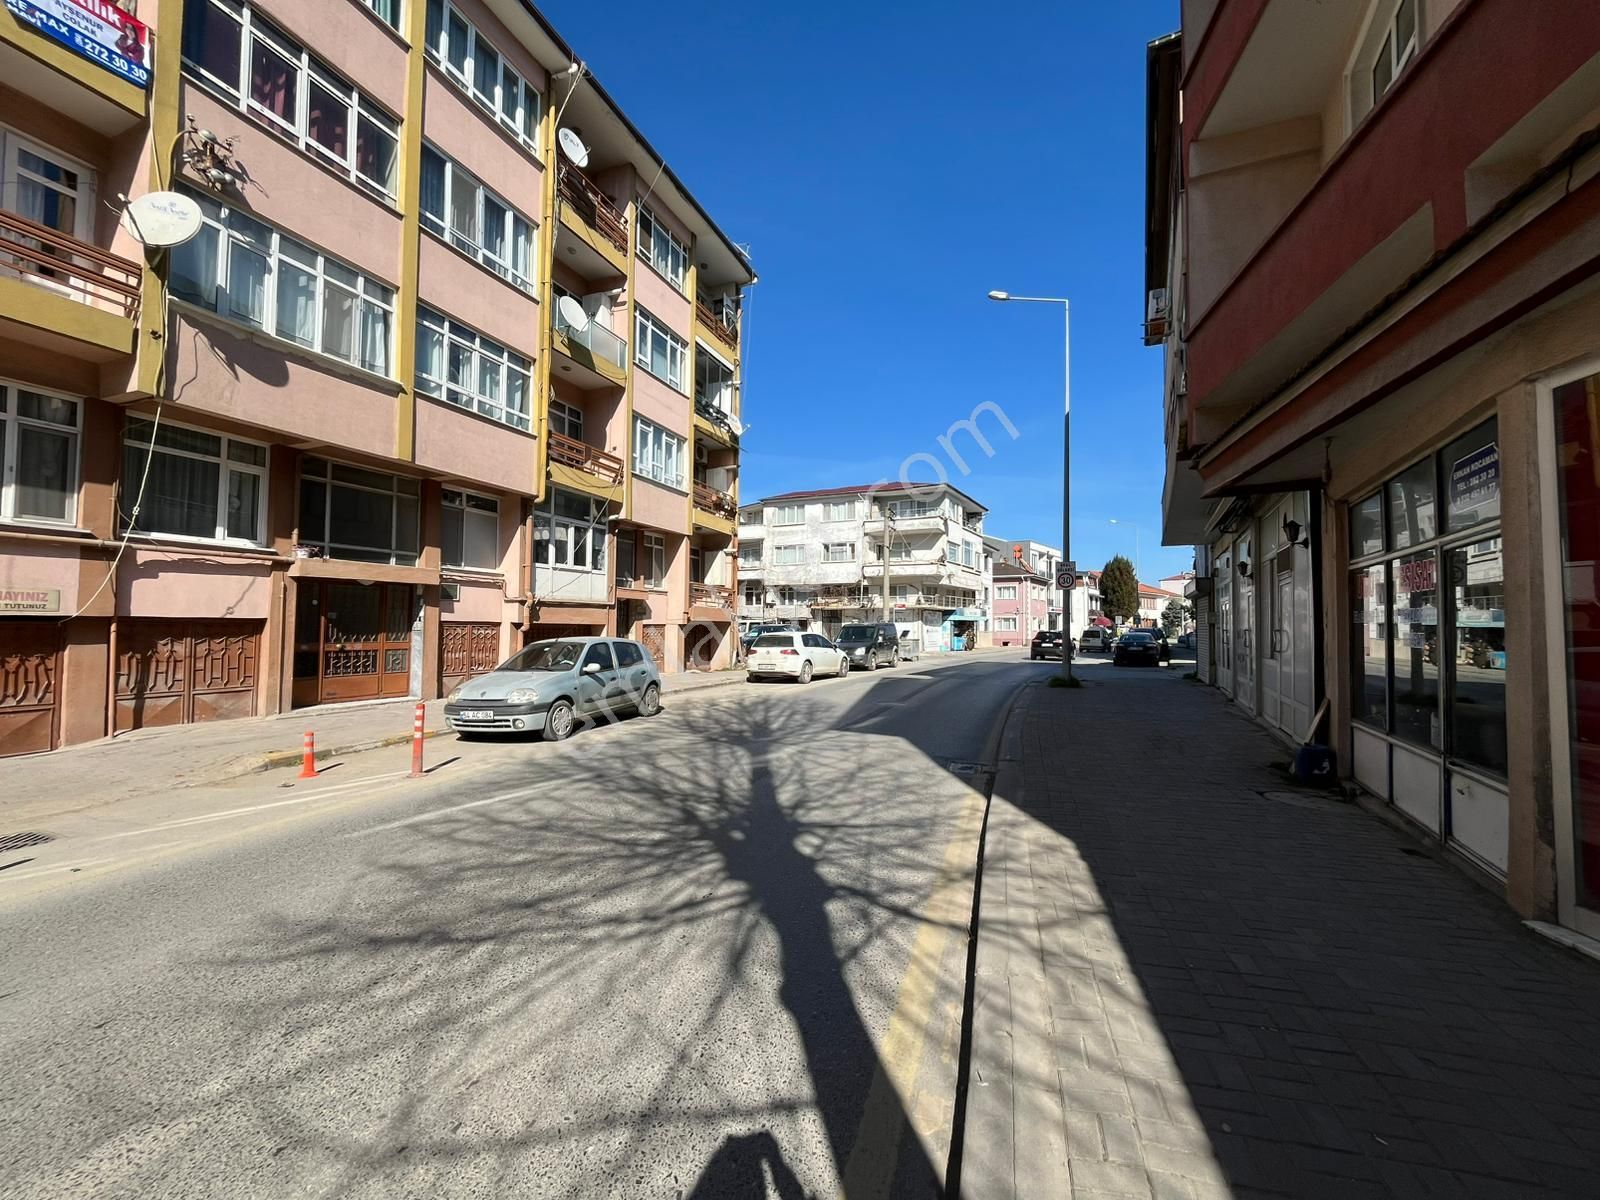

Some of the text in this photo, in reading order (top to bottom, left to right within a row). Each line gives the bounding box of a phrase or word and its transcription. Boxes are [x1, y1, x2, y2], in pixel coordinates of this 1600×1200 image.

[111, 54, 129, 71] 30
[130, 64, 147, 81] 30
[1061, 576, 1071, 585] 30
[471, 711, 481, 719] AC
